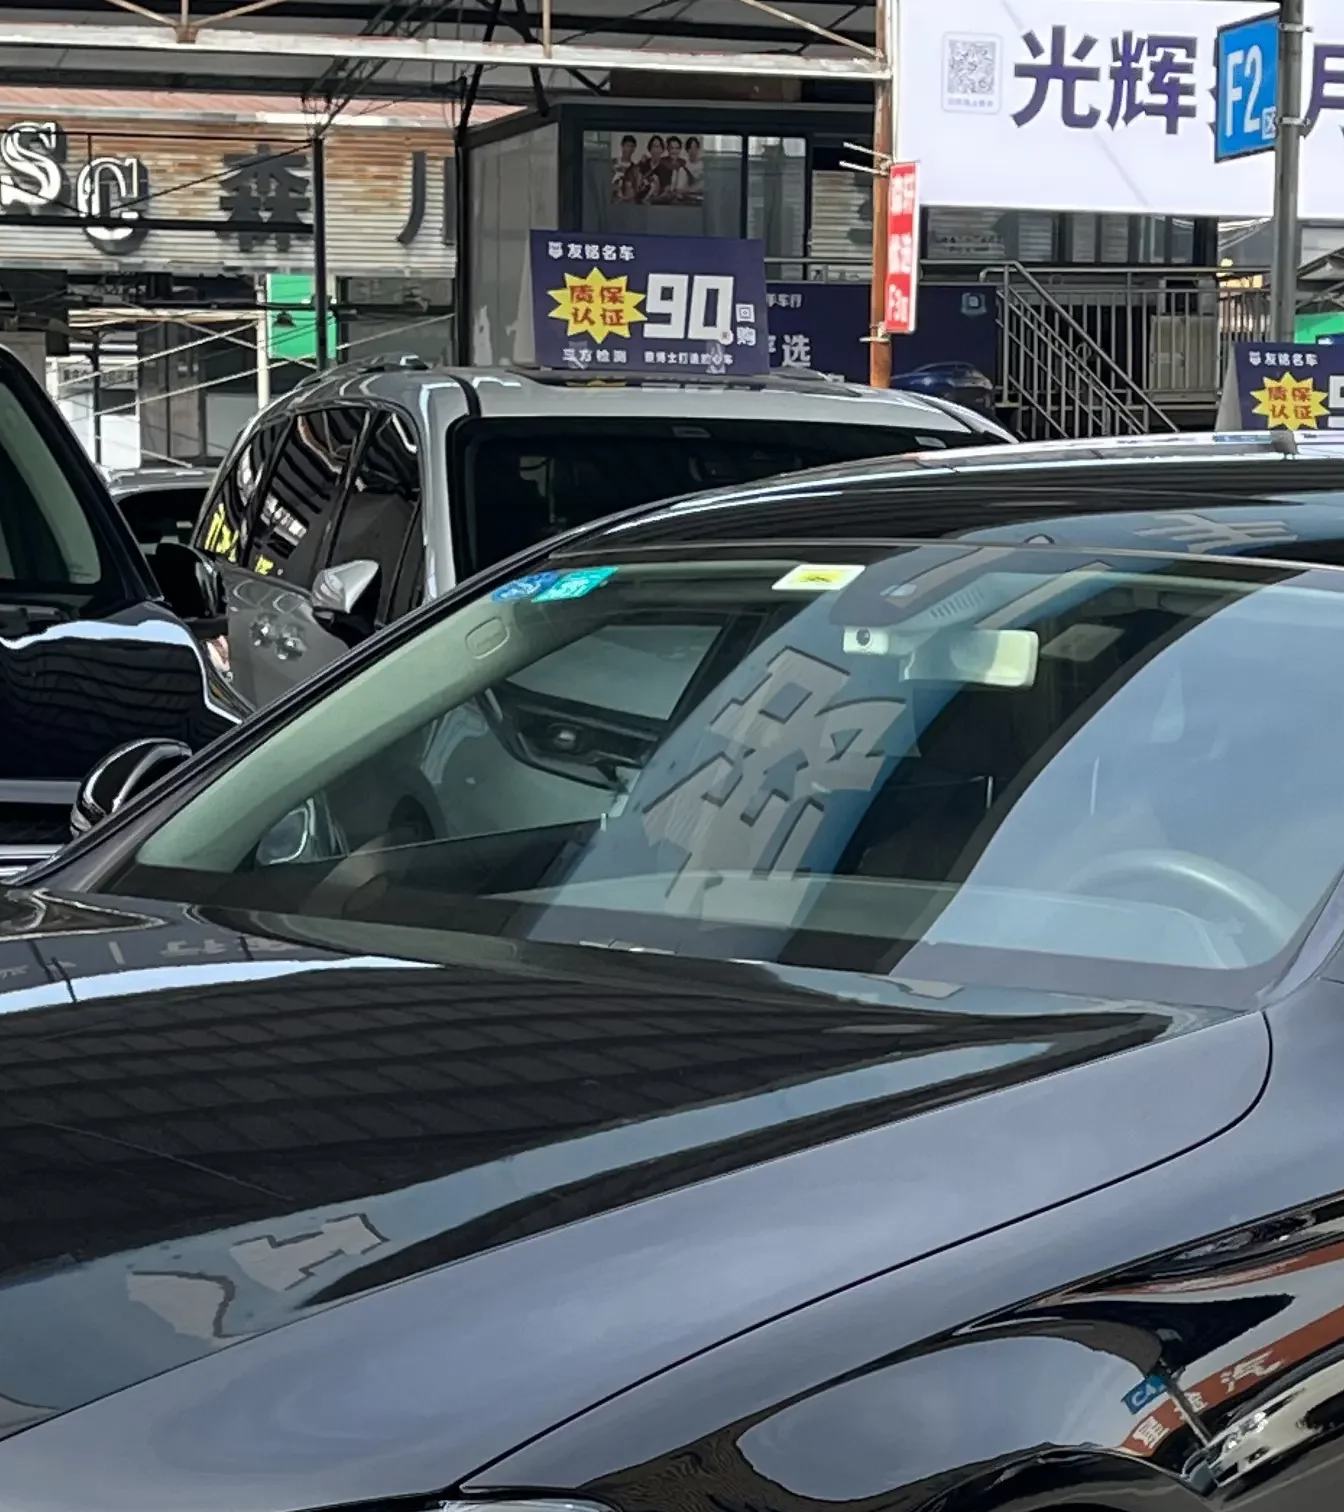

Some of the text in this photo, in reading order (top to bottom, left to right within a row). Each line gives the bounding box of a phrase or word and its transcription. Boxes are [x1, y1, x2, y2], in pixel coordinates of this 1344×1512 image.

[1225, 44, 1263, 138] F2
[567, 243, 636, 261] 友铭名车
[568, 284, 625, 304] 质保
[571, 306, 627, 326] 认证
[643, 273, 734, 339] 90
